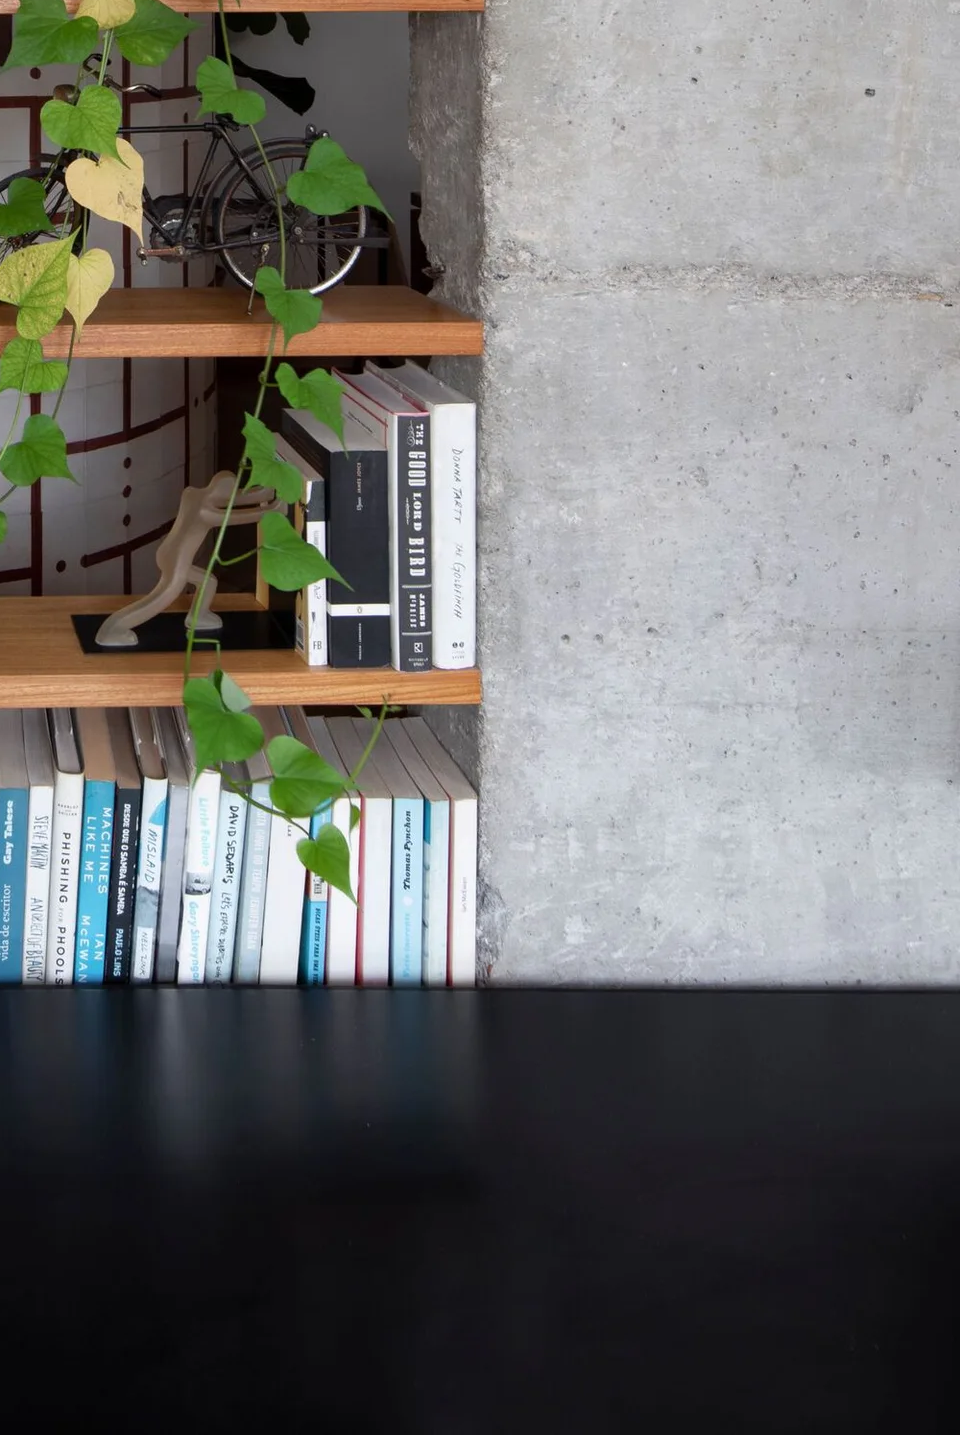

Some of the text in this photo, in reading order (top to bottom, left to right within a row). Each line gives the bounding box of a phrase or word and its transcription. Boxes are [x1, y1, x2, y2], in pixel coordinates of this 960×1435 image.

[408, 451, 426, 486] GOOD
[452, 448, 464, 524] DONNA TARTT
[412, 492, 422, 531] LORD
[408, 537, 426, 577] BIRD
[313, 640, 322, 650] FB
[3, 801, 14, 865] Gay Talese
[122, 803, 131, 827] DESDE
[199, 797, 212, 867] Little Failure
[30, 815, 49, 869] STEVE MARTIN
[84, 817, 96, 883] LIKE ME
[98, 807, 110, 894] MACHINES
[119, 851, 128, 879] SAMBA
[144, 829, 158, 883] MISLAID
[222, 805, 239, 884] DAVID SEDARIS
[403, 811, 413, 891] Thomas Pynchon
[0, 884, 11, 961] vida de escritor
[30, 897, 43, 913] AN
[56, 833, 71, 985] PHISHING PHOOLS
[116, 887, 126, 915] SAMBA
[187, 901, 198, 926] Gary
[78, 915, 90, 983] McEWAN
[94, 934, 104, 960] IAN
[114, 929, 124, 977] PAULO LINS
[140, 932, 148, 953] NELL
